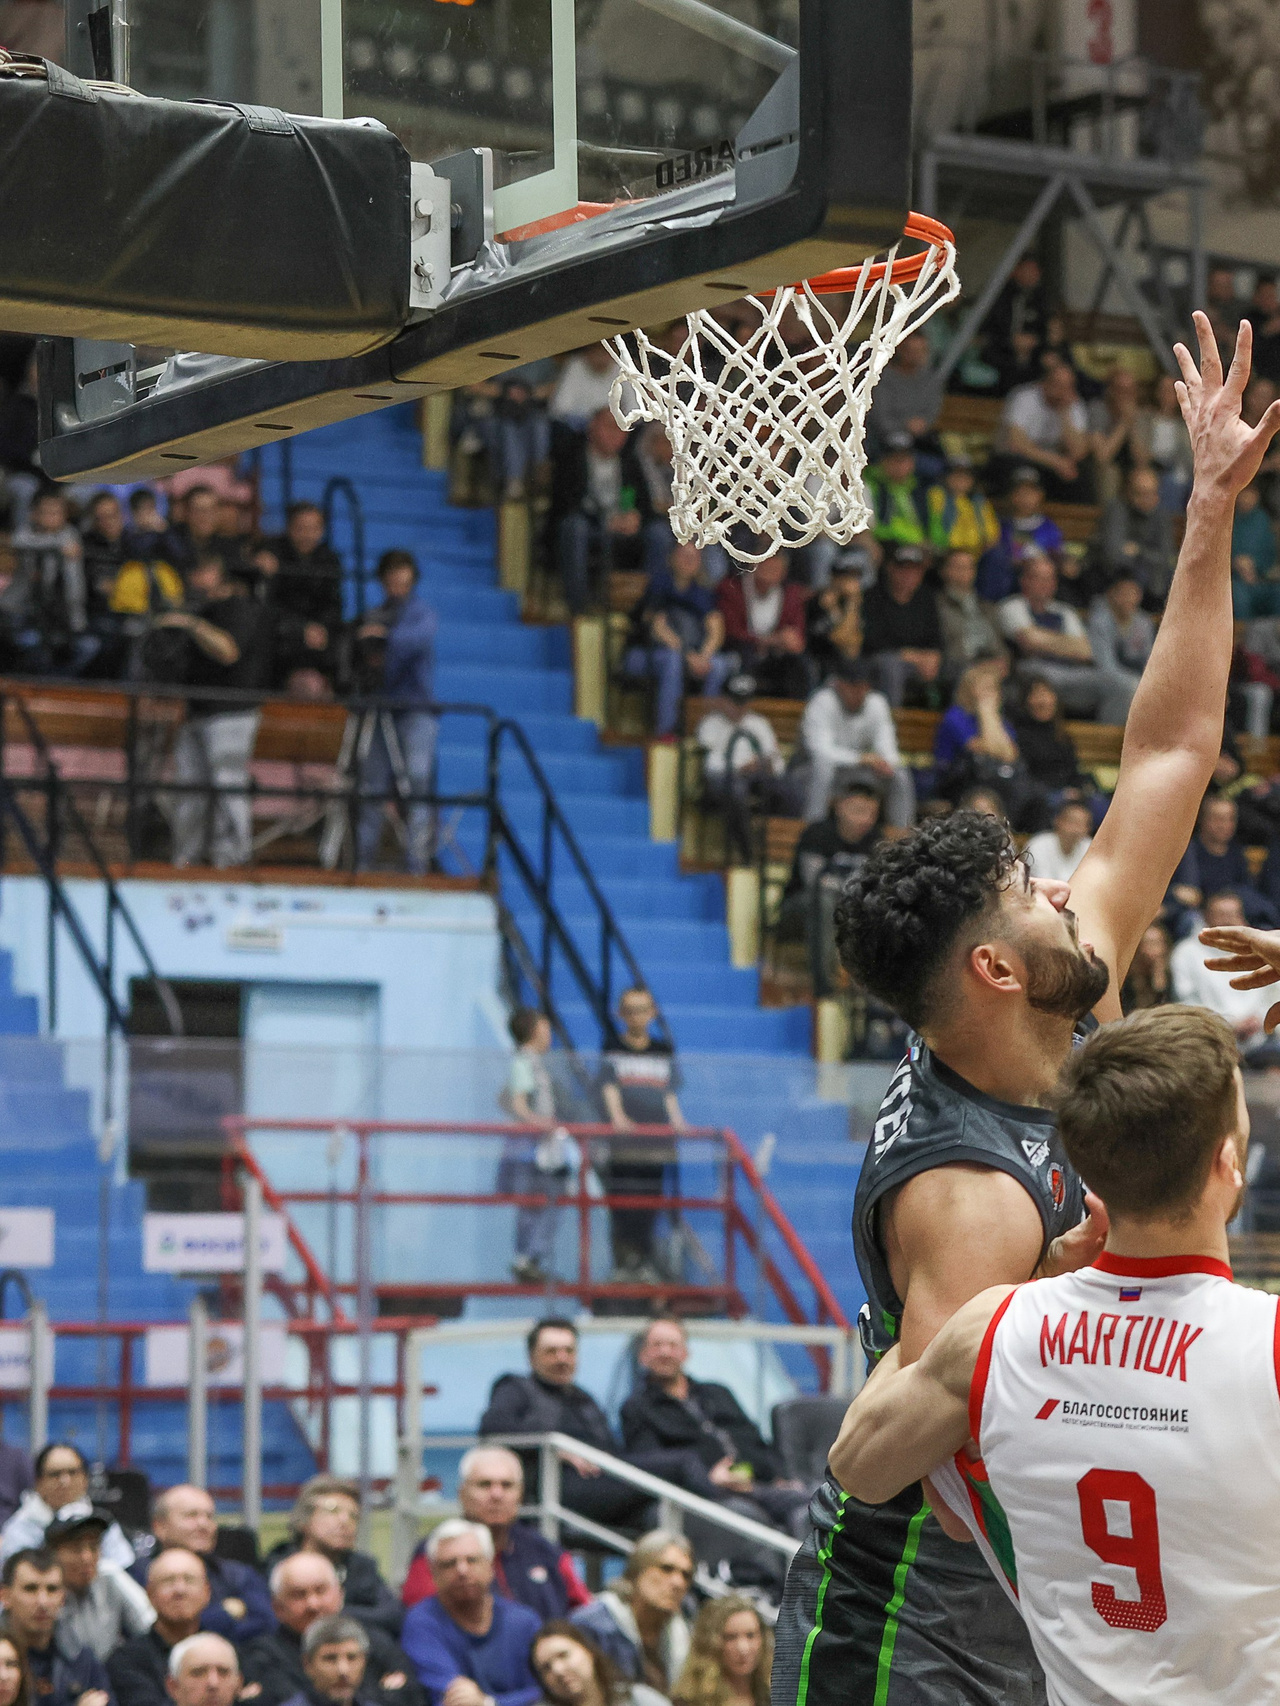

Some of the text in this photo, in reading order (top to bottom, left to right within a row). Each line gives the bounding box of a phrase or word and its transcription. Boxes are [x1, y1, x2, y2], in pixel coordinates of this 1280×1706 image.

[1039, 1311, 1204, 1382] MARTIUK
[1062, 1400, 1189, 1423] БЛАГОСОСТОЯНИЕ
[1076, 1468, 1167, 1632] 9
